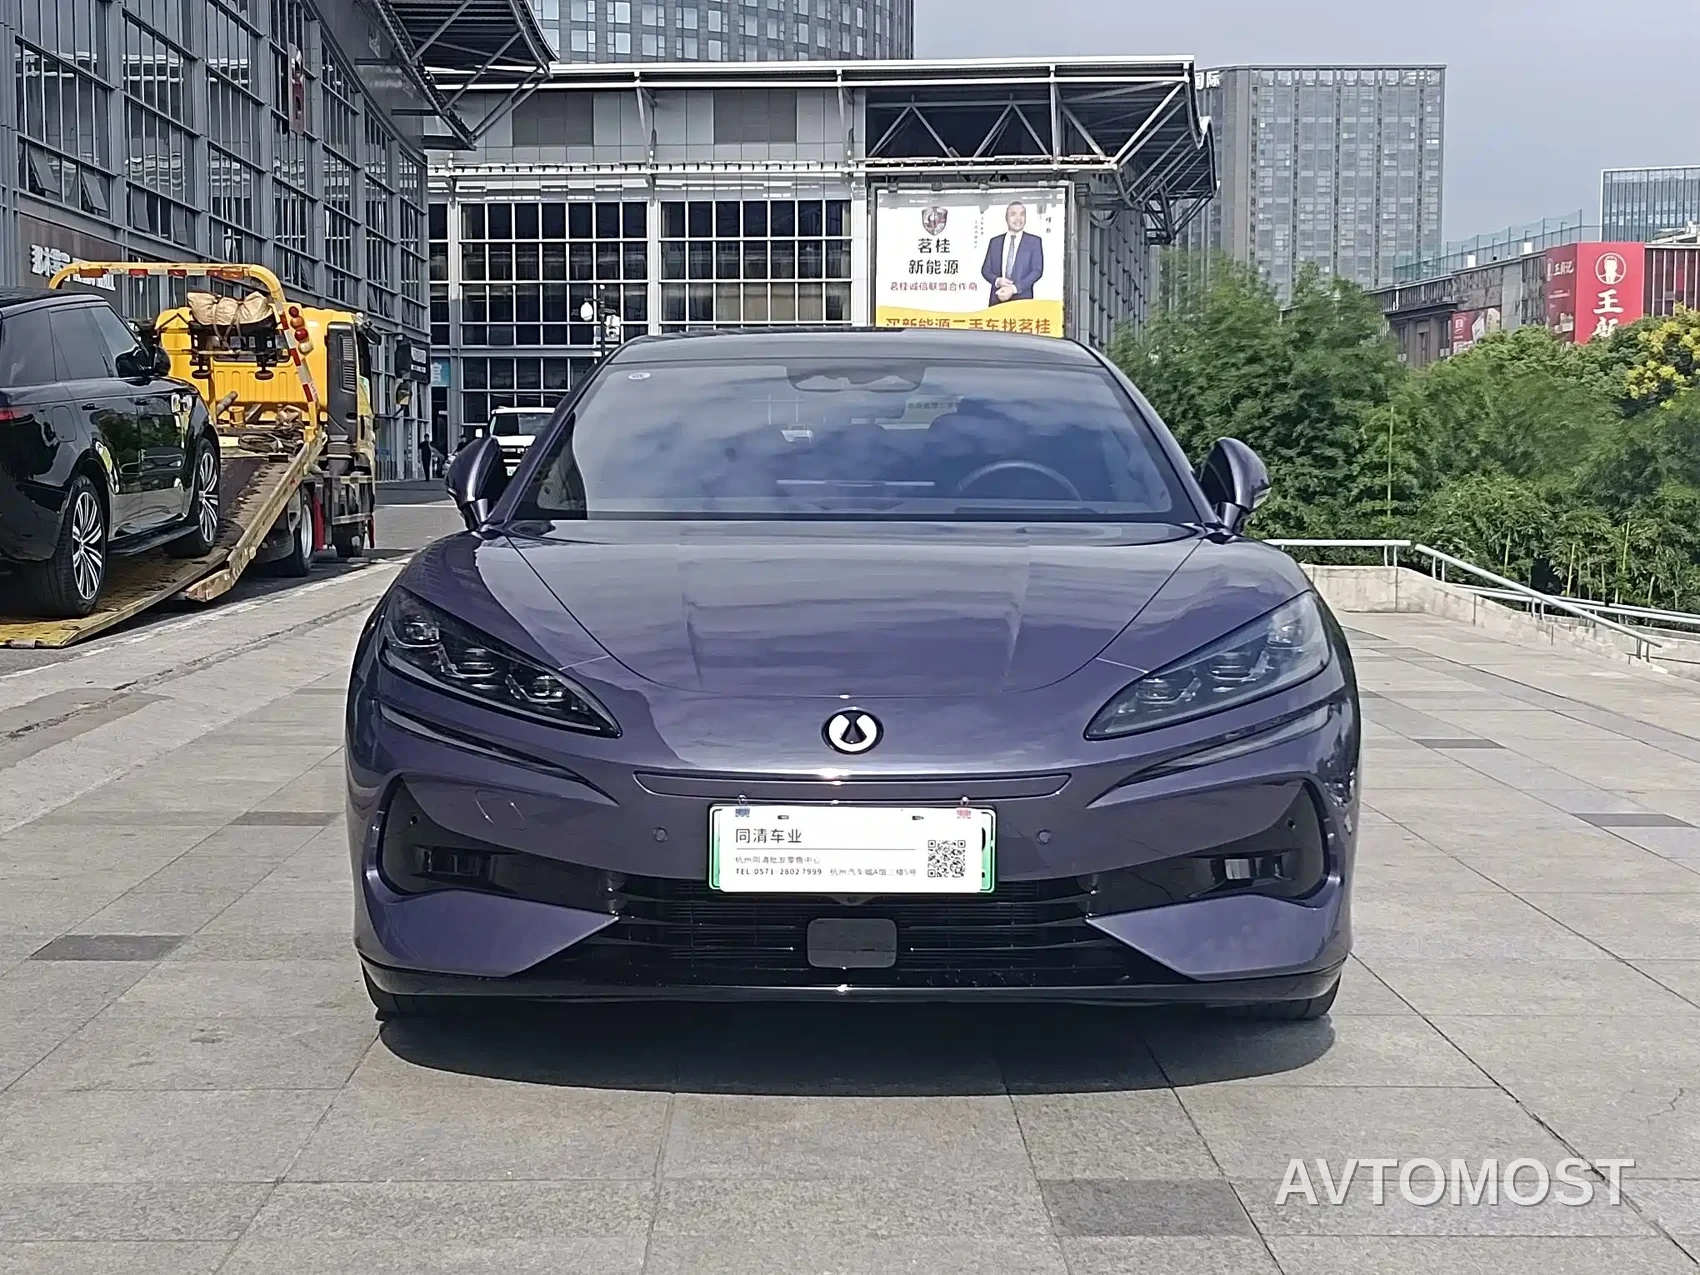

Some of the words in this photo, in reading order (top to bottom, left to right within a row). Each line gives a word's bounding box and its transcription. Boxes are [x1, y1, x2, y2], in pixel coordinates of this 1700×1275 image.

[918, 238, 950, 253] 茗桂
[908, 259, 959, 275] 新能源
[735, 828, 802, 843] 同清车业
